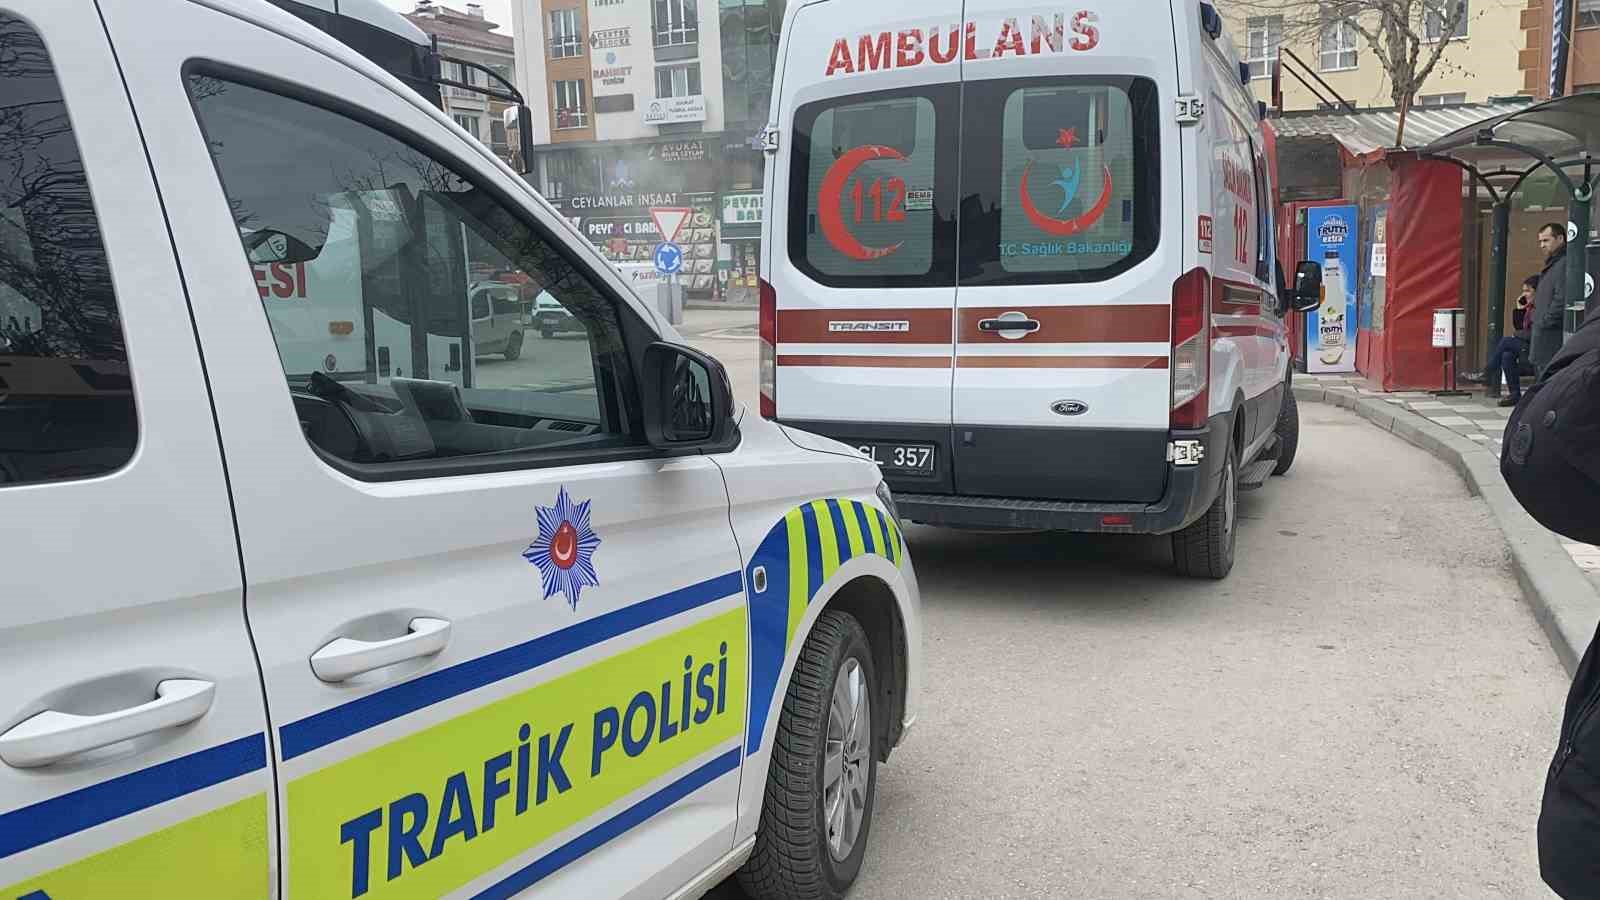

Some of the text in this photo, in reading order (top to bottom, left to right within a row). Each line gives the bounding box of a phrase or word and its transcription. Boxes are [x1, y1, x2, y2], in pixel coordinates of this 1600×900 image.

[825, 9, 1100, 76] AMBULANS
[571, 195, 633, 209] CEYLANLAR
[850, 175, 905, 224] 112
[1200, 217, 1212, 239] 112
[1234, 203, 1248, 265] 112
[1021, 241, 1062, 256] Sağlık
[829, 320, 910, 332] TRANSIT
[893, 446, 931, 468] 357
[339, 640, 728, 900] TRAFİK POLİSİ
